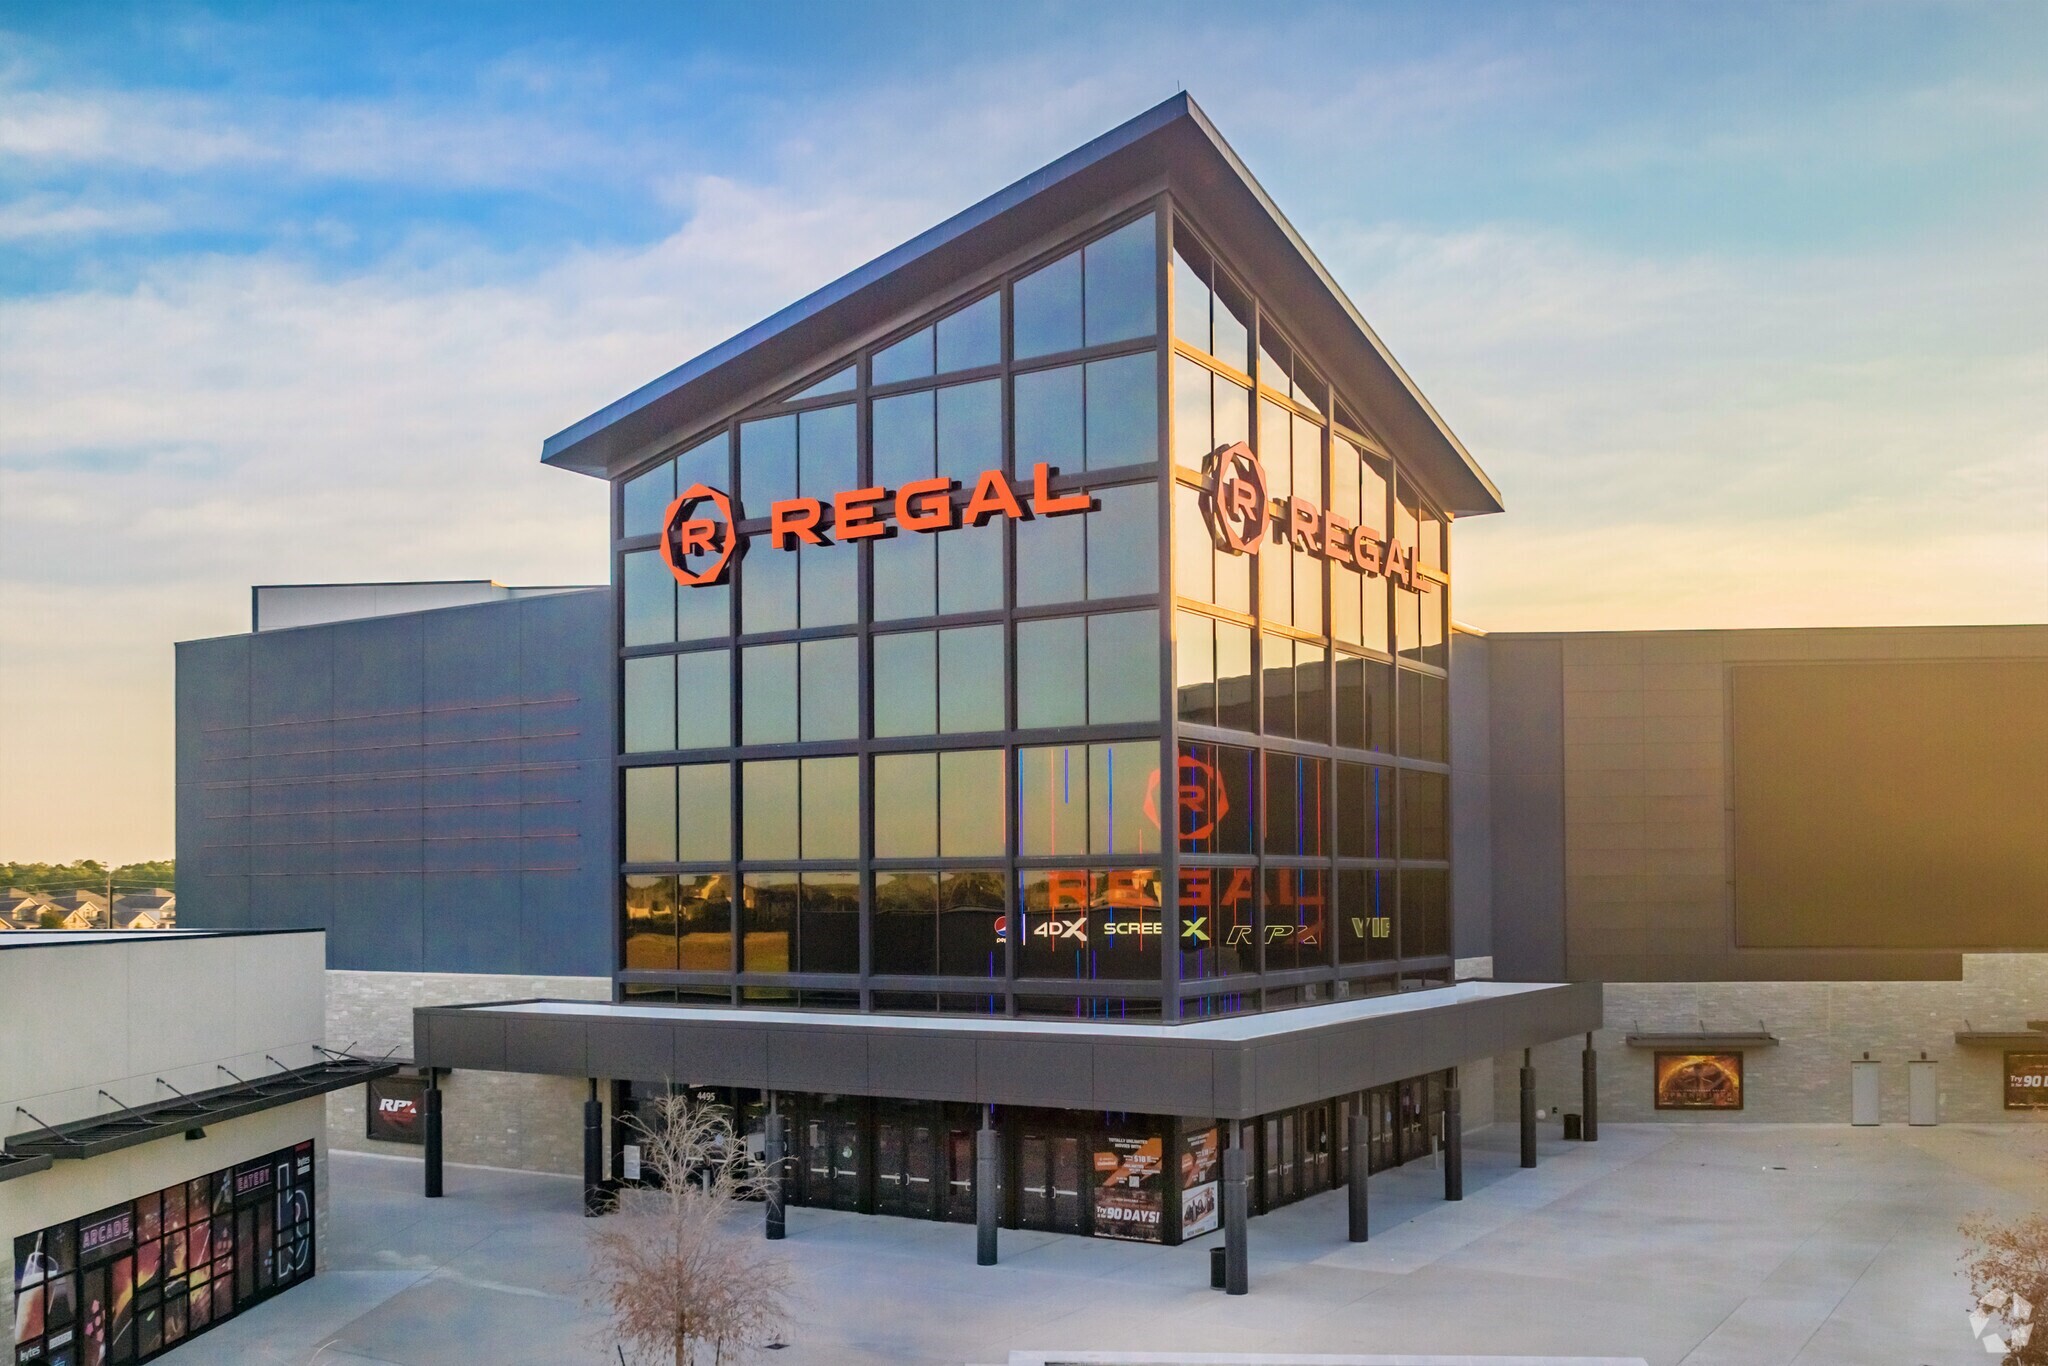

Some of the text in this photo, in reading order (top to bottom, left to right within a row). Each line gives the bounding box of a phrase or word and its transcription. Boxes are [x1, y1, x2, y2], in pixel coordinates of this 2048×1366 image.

[771, 462, 1091, 550] REGAL
[1288, 496, 1432, 593] REGAL
[1048, 868, 1325, 906] REGAL
[1033, 917, 1088, 942] 4DX
[2010, 1075, 2022, 1083] Try
[2023, 1075, 2042, 1087] 90
[379, 1098, 417, 1114] RPX
[697, 1091, 716, 1101] 4495
[237, 1168, 270, 1192] EATERY
[1096, 1206, 1160, 1224] Try 90 DAYS!
[82, 1217, 130, 1249] ARCADE
[20, 1346, 41, 1362] bytes
